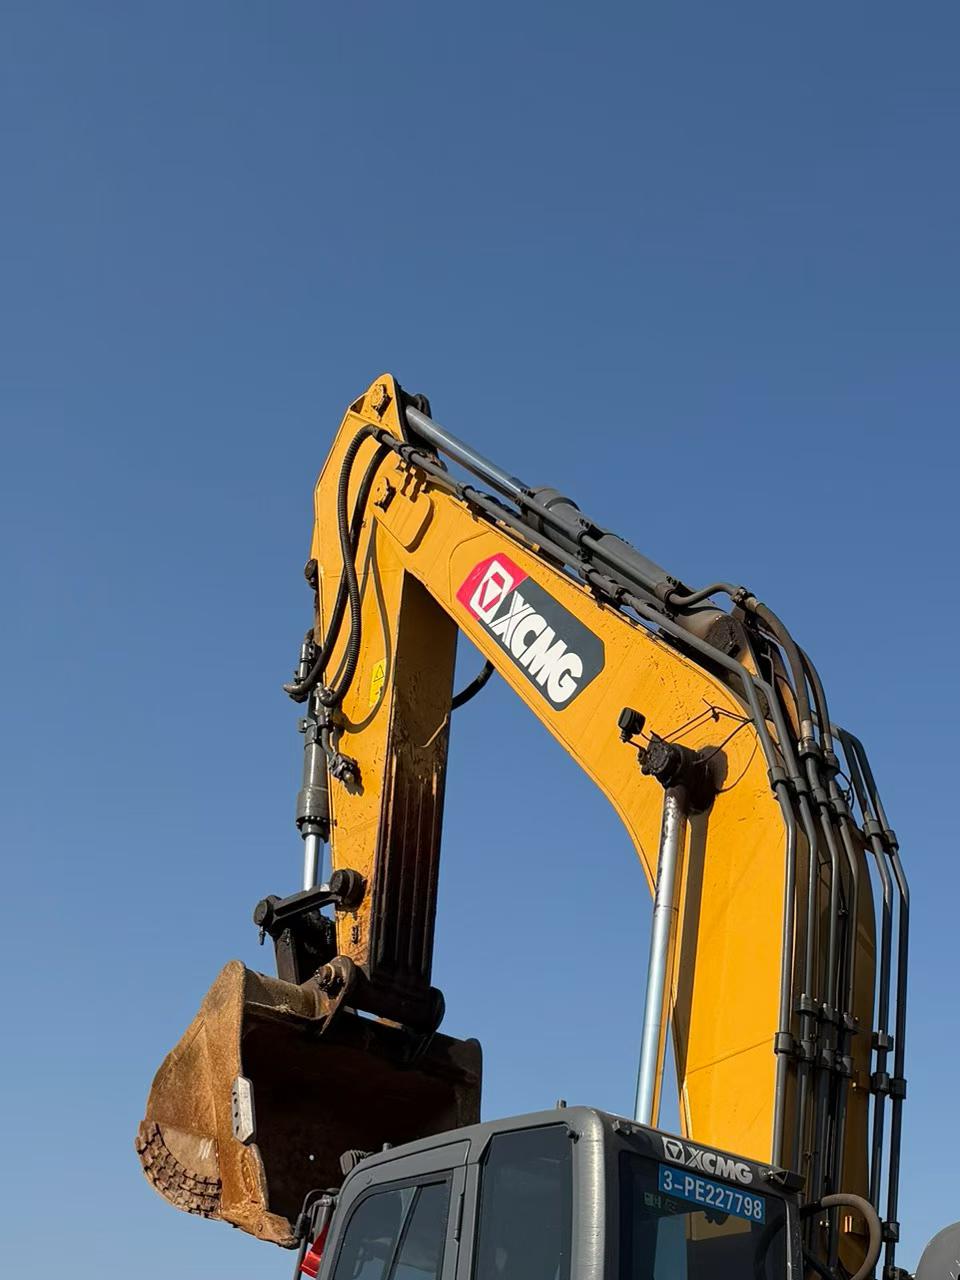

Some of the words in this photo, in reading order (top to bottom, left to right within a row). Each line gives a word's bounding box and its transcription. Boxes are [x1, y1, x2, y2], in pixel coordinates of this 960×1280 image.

[488, 590, 584, 703] XCMG
[685, 1146, 753, 1185] XCMG
[663, 1170, 763, 1221] 3-PE227798
